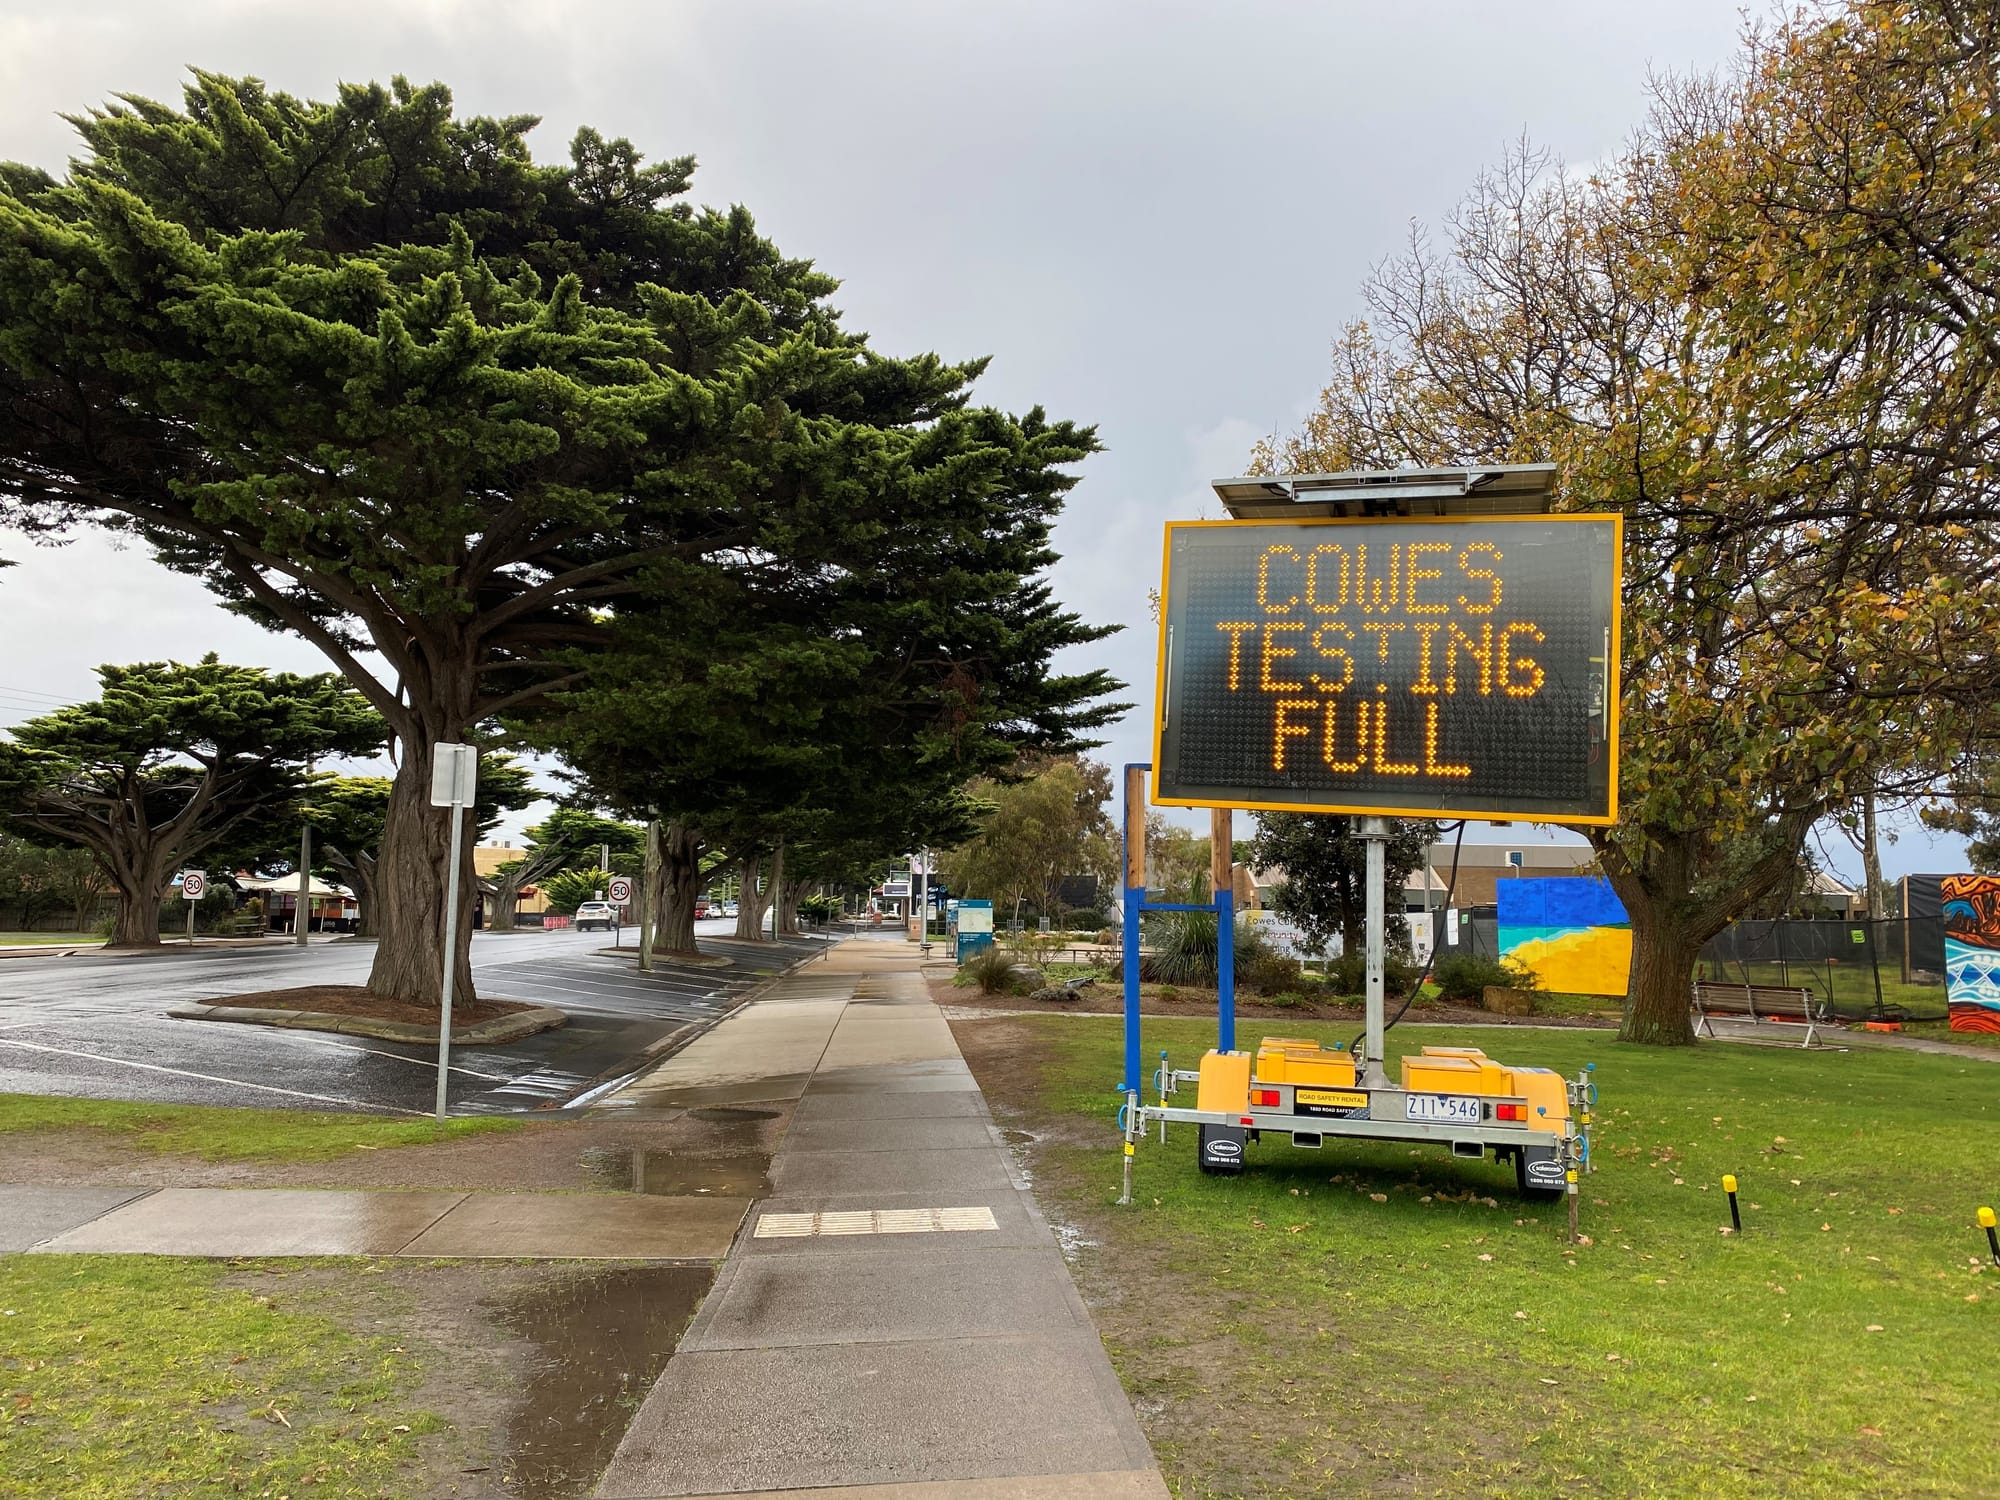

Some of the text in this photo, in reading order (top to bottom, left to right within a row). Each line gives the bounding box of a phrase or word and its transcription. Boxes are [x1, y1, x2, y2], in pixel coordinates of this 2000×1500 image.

[1258, 542, 1503, 614] COWES
[1216, 621, 1546, 697] TESTING
[1273, 699, 1472, 777] FULL
[188, 880, 200, 889] 50
[614, 886, 626, 896] 50
[1317, 1094, 1340, 1102] SAFETY
[1449, 1100, 1477, 1117] 546
